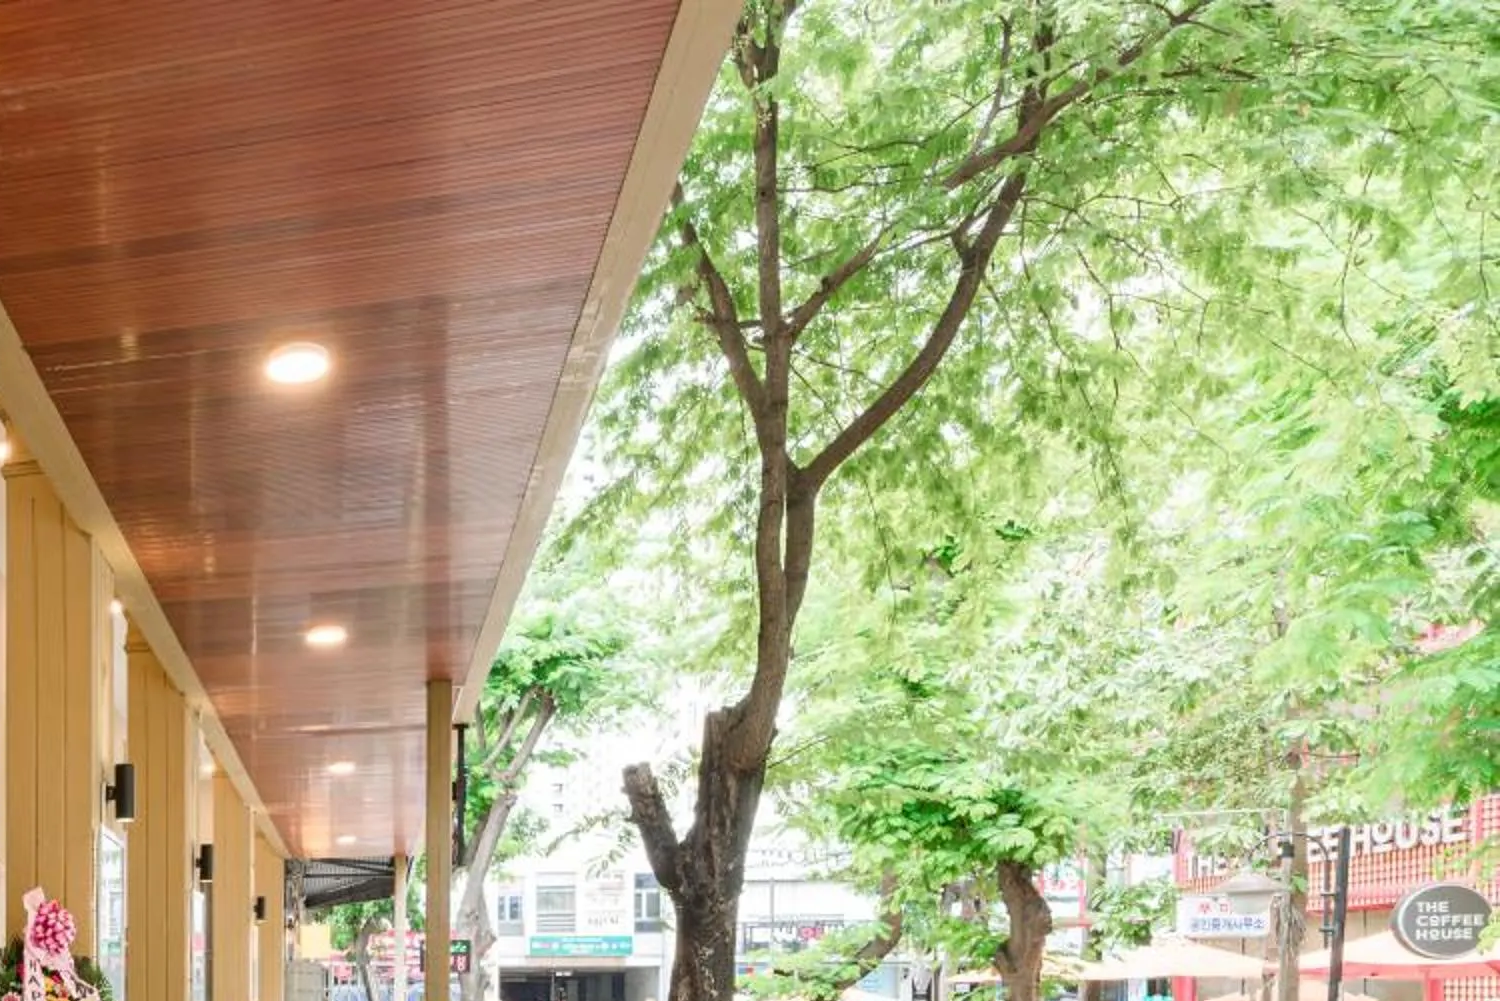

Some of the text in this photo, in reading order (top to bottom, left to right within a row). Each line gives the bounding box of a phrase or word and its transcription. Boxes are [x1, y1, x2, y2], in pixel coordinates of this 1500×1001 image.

[1351, 806, 1466, 855] HOUSE
[1415, 900, 1449, 914] THE
[1415, 914, 1484, 927] COFFEE
[1415, 927, 1473, 941] HOUSE
